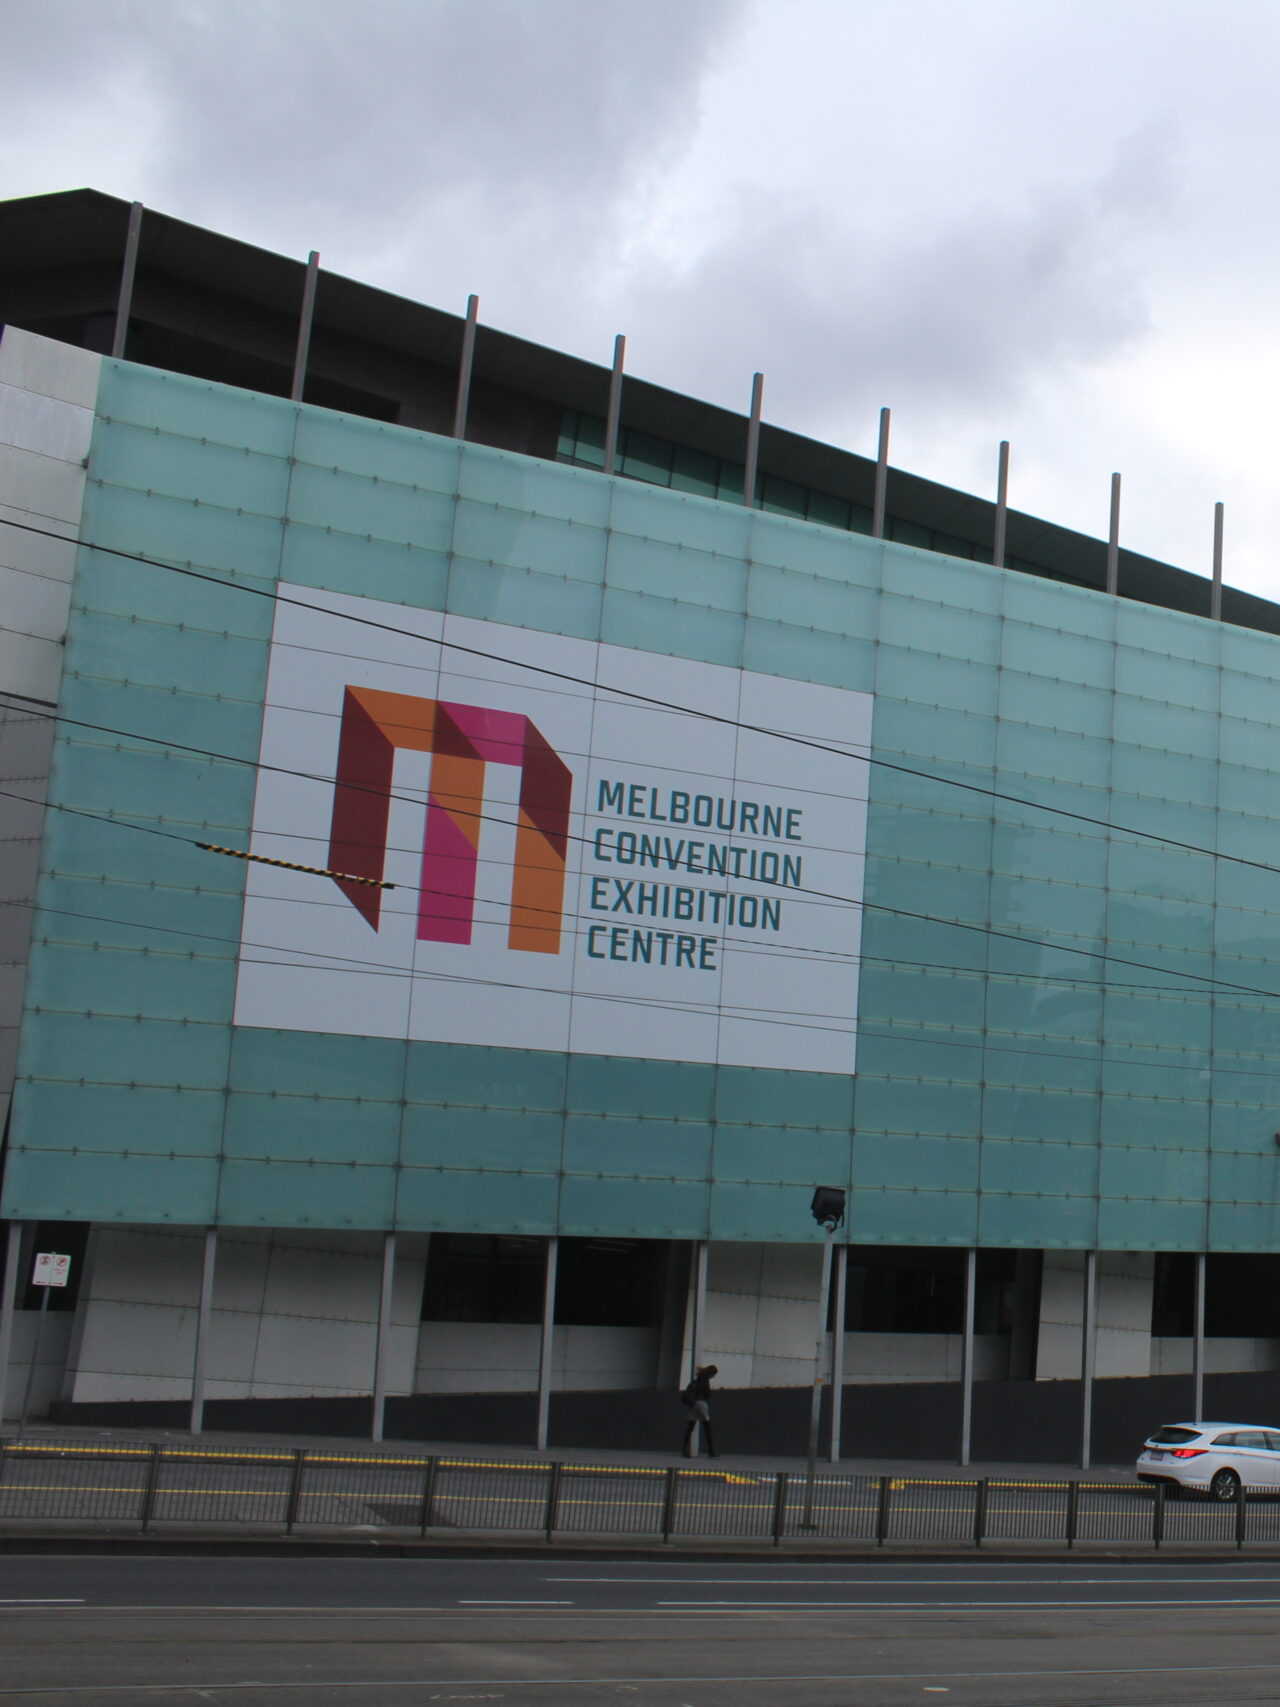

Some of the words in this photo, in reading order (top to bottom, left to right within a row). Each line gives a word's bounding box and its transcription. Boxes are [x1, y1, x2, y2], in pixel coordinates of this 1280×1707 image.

[597, 779, 802, 840] MELBOURNE
[594, 828, 802, 886] CONVENTION
[590, 876, 781, 931] EXHIBITION
[587, 925, 717, 971] CENTRE
